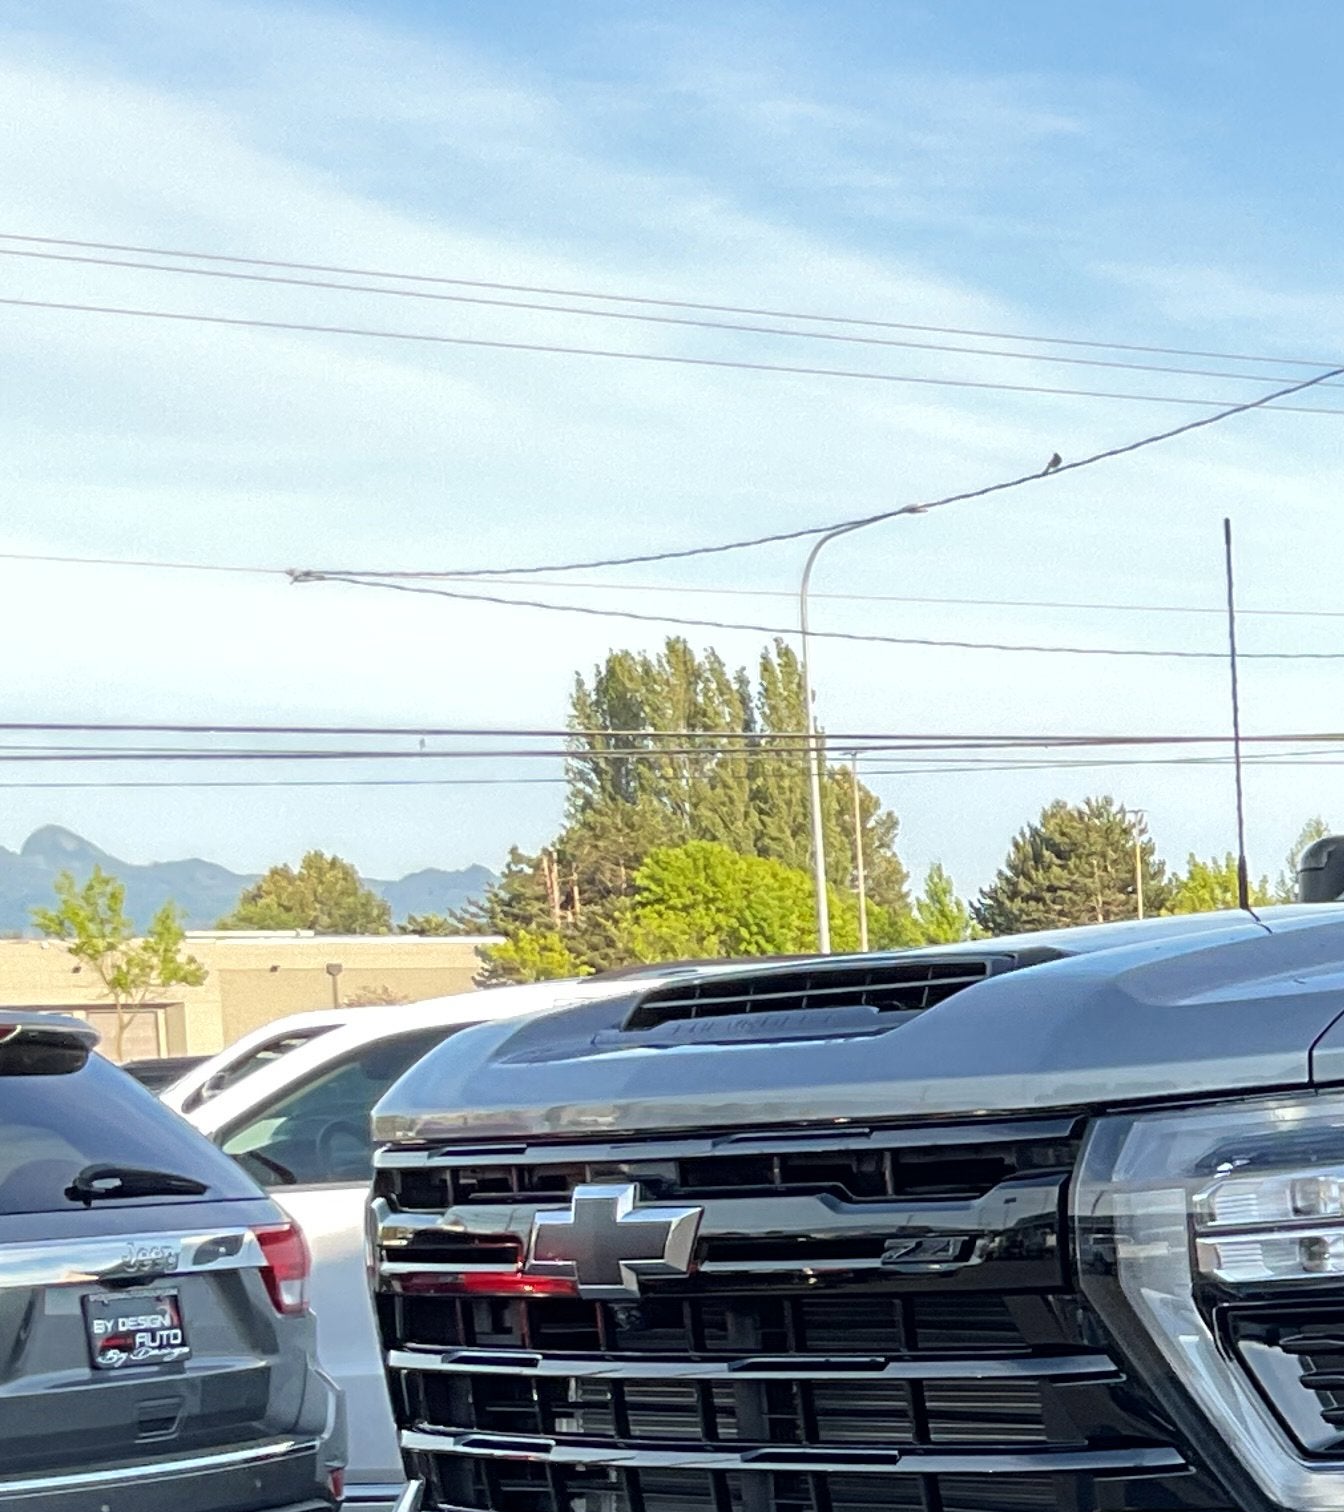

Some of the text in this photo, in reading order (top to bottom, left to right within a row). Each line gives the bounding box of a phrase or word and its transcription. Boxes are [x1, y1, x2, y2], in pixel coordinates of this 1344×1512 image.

[121, 1242, 178, 1267] Jeep
[93, 1315, 170, 1333] BY DESIGN
[136, 1329, 181, 1346] AUTO
